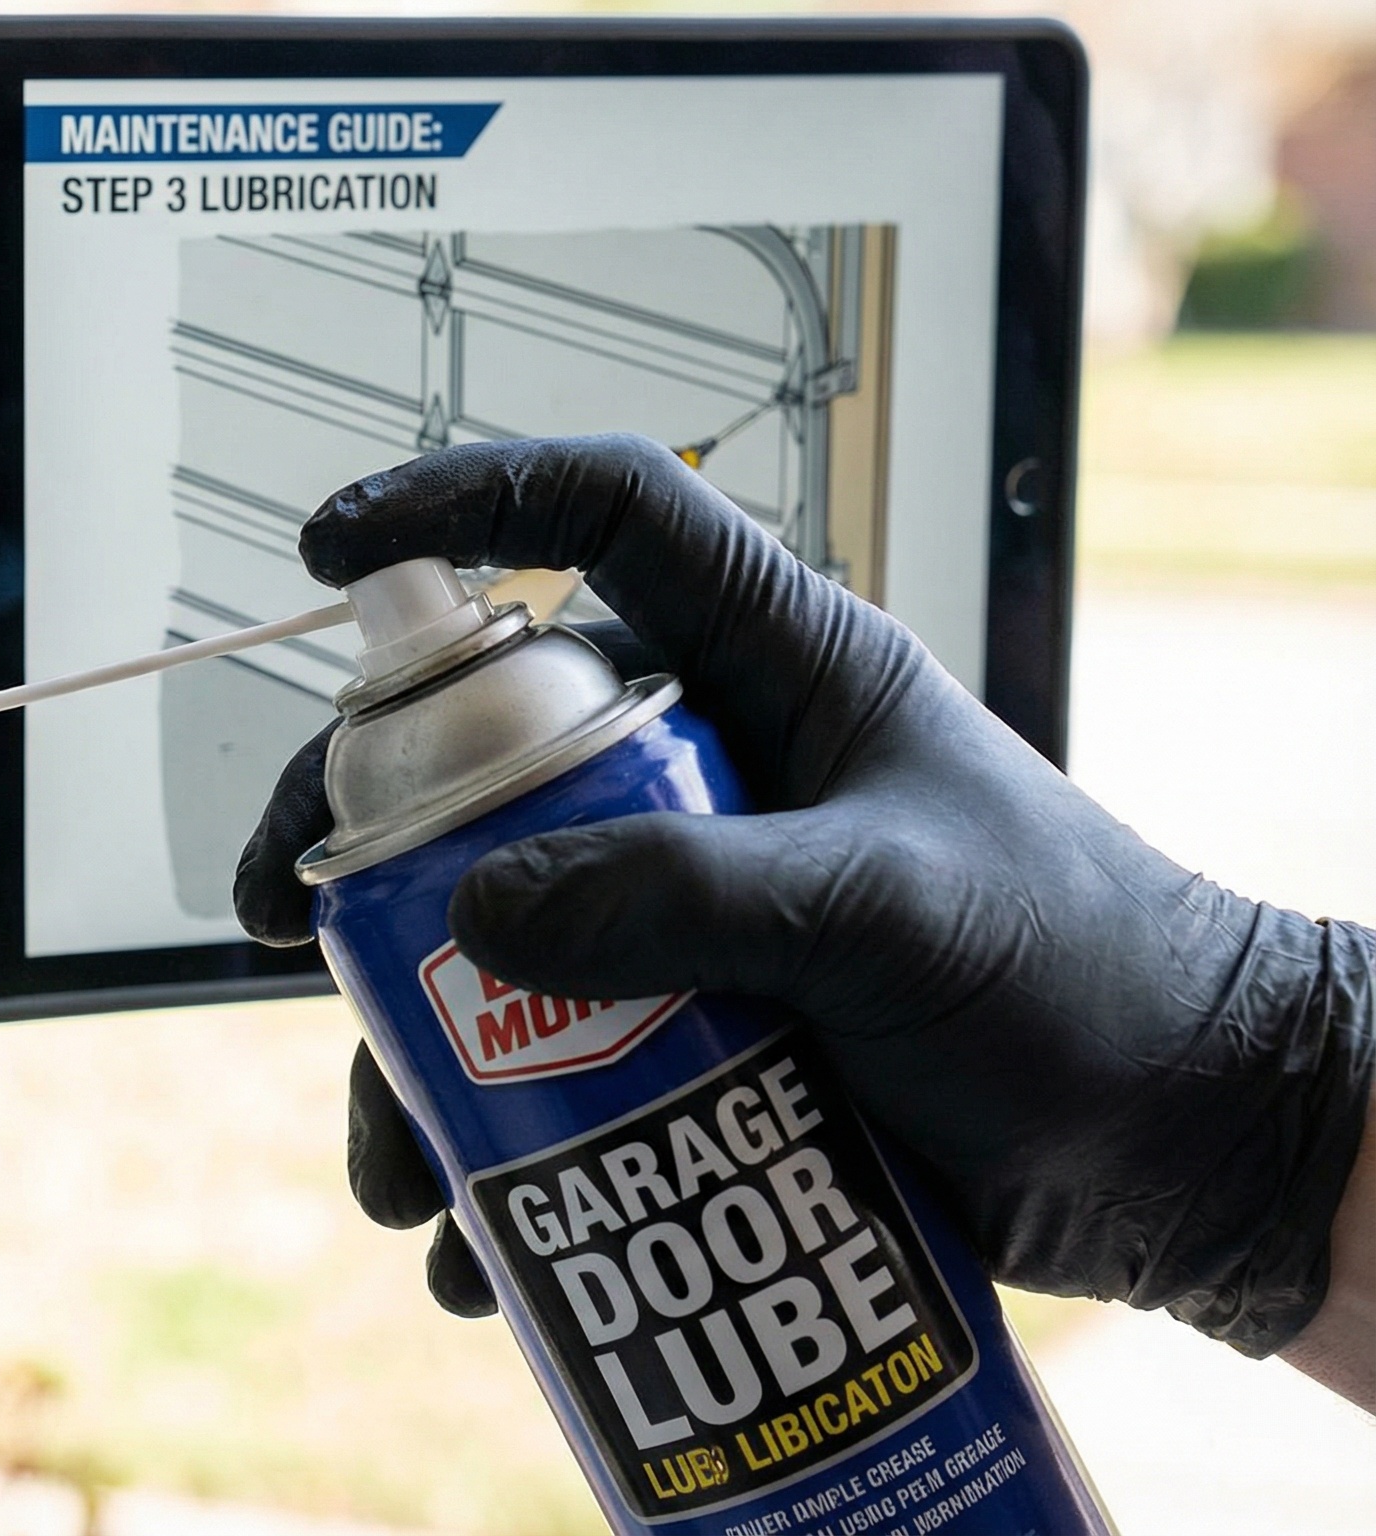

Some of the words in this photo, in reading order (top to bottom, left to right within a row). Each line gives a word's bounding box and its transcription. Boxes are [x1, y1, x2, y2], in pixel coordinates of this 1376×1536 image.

[61, 113, 319, 155] MAINTENANCE
[327, 113, 442, 152] GUIDE:
[62, 177, 153, 213] STEP
[167, 178, 186, 213] 3
[201, 174, 438, 212] LUBRICATION
[507, 1057, 824, 1257] GARAGE
[552, 1147, 859, 1346] DOOR
[593, 1227, 919, 1451] LUBE
[736, 1333, 944, 1472] LIBICATON
